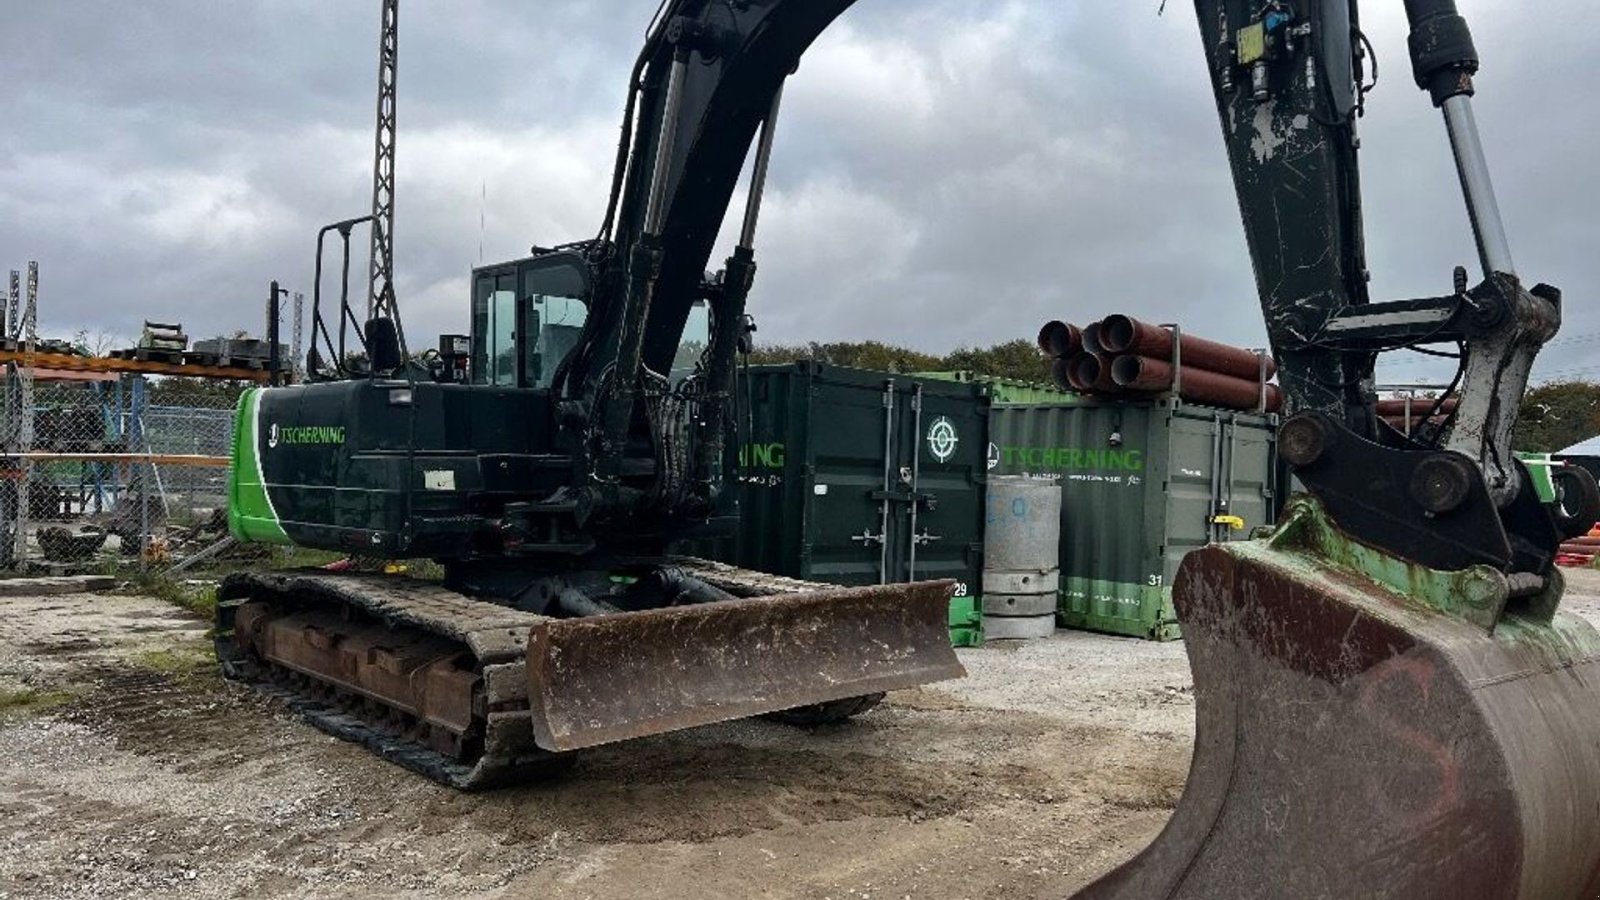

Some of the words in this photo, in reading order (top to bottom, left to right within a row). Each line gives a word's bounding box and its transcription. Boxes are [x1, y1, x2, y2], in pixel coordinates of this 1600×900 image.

[281, 426, 345, 444] TSCHERNING
[1003, 447, 1144, 470] TSCHERNING
[1148, 574, 1162, 586] 31
[954, 582, 967, 597] 29
